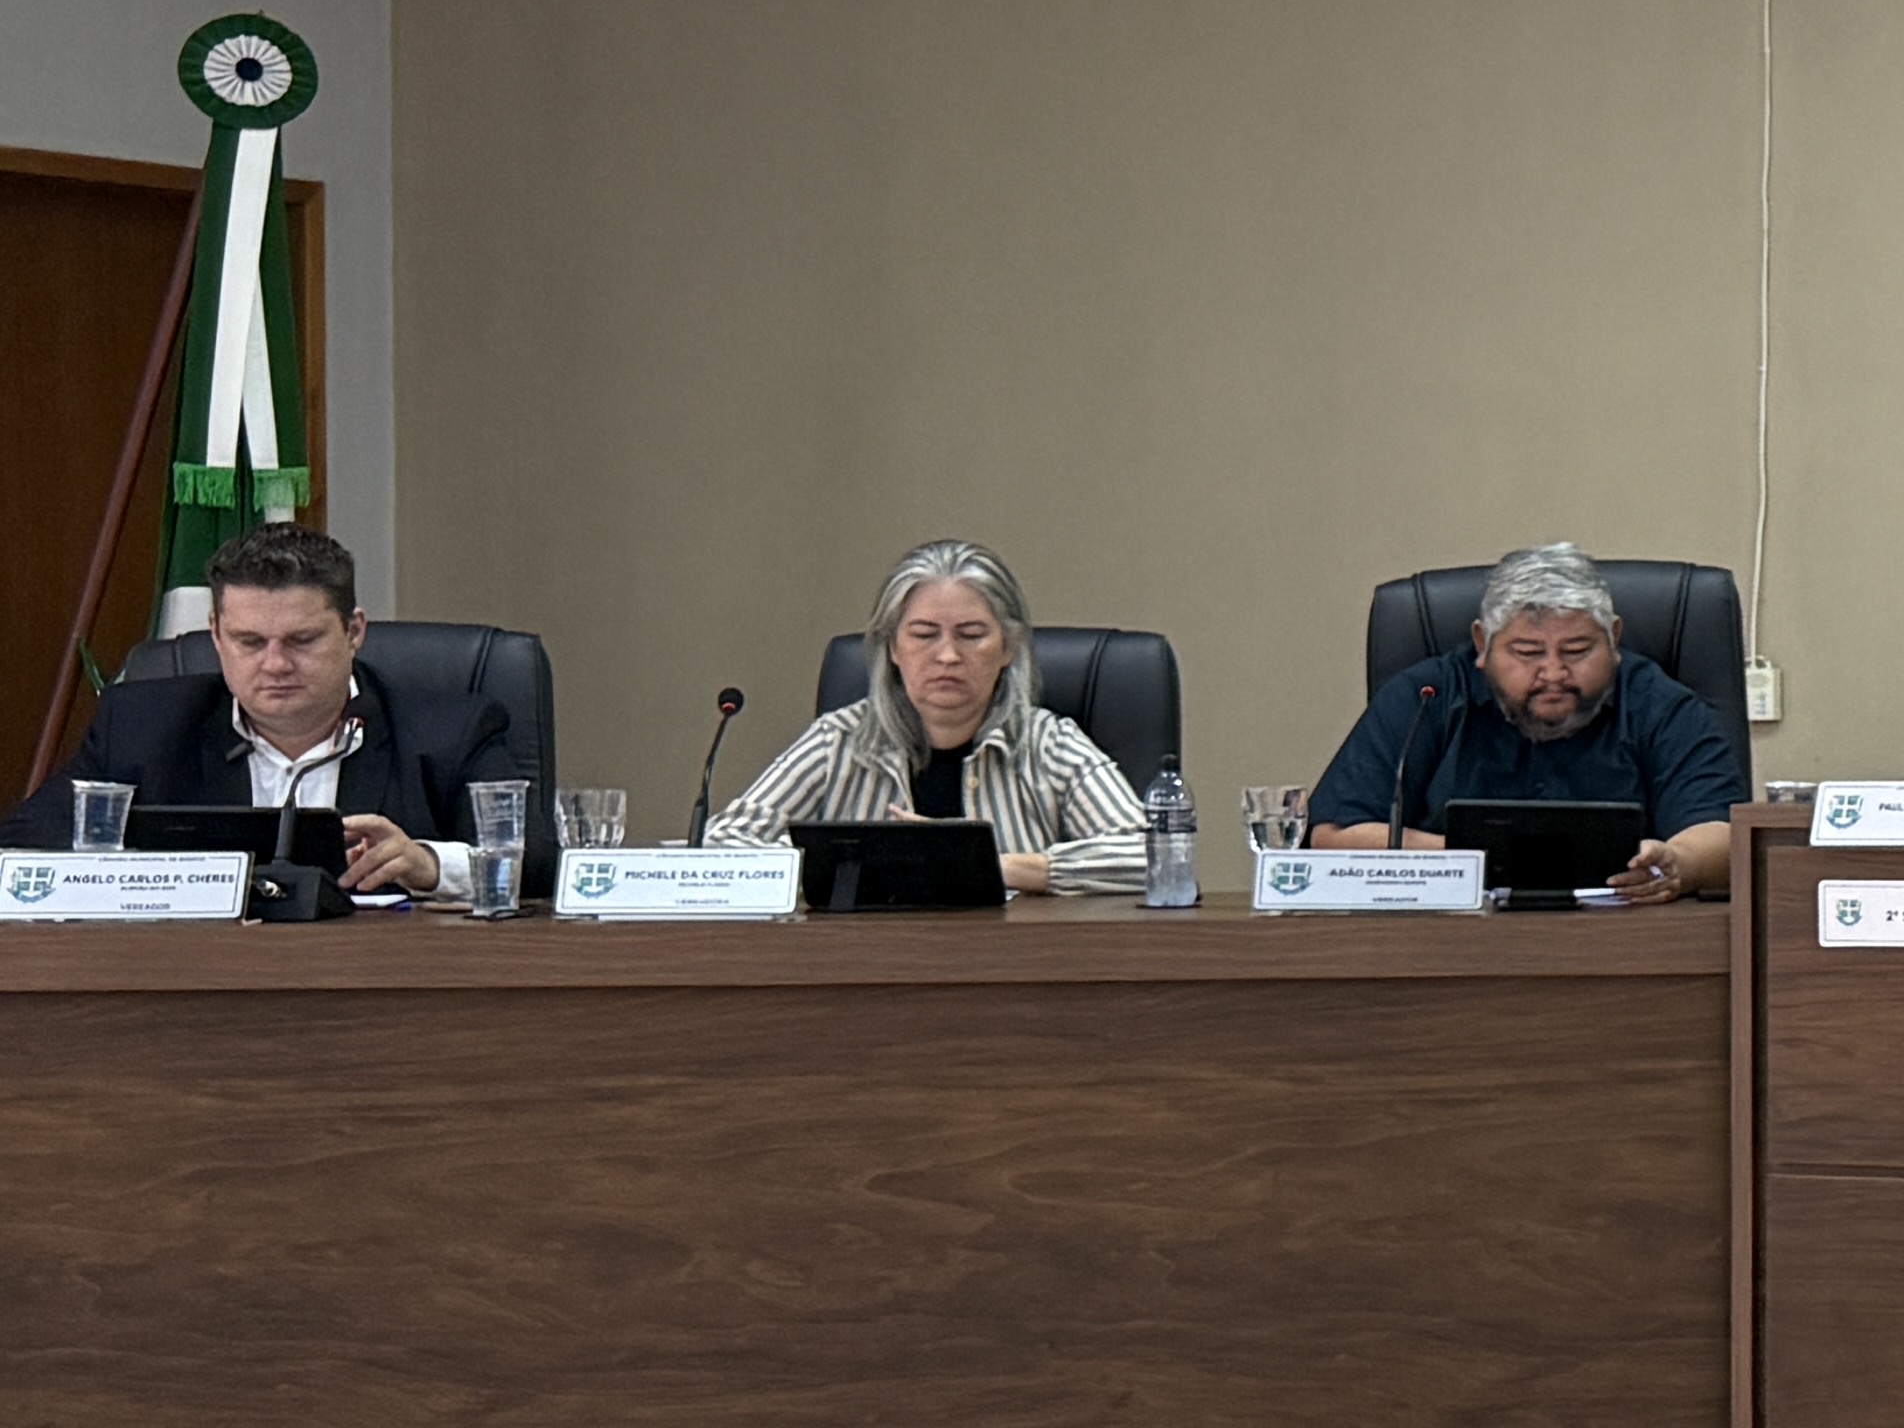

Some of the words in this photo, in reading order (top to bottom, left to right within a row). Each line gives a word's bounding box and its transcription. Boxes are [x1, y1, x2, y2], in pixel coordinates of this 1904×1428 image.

[625, 871, 677, 880] MICHELE
[681, 871, 697, 880] DA
[702, 871, 735, 880] CRUZ
[738, 871, 785, 880] FLORES
[1367, 869, 1416, 878] CARLOS
[1419, 869, 1465, 878] DUARTE
[62, 874, 115, 884] ANGELO
[119, 874, 169, 884] CARLOS
